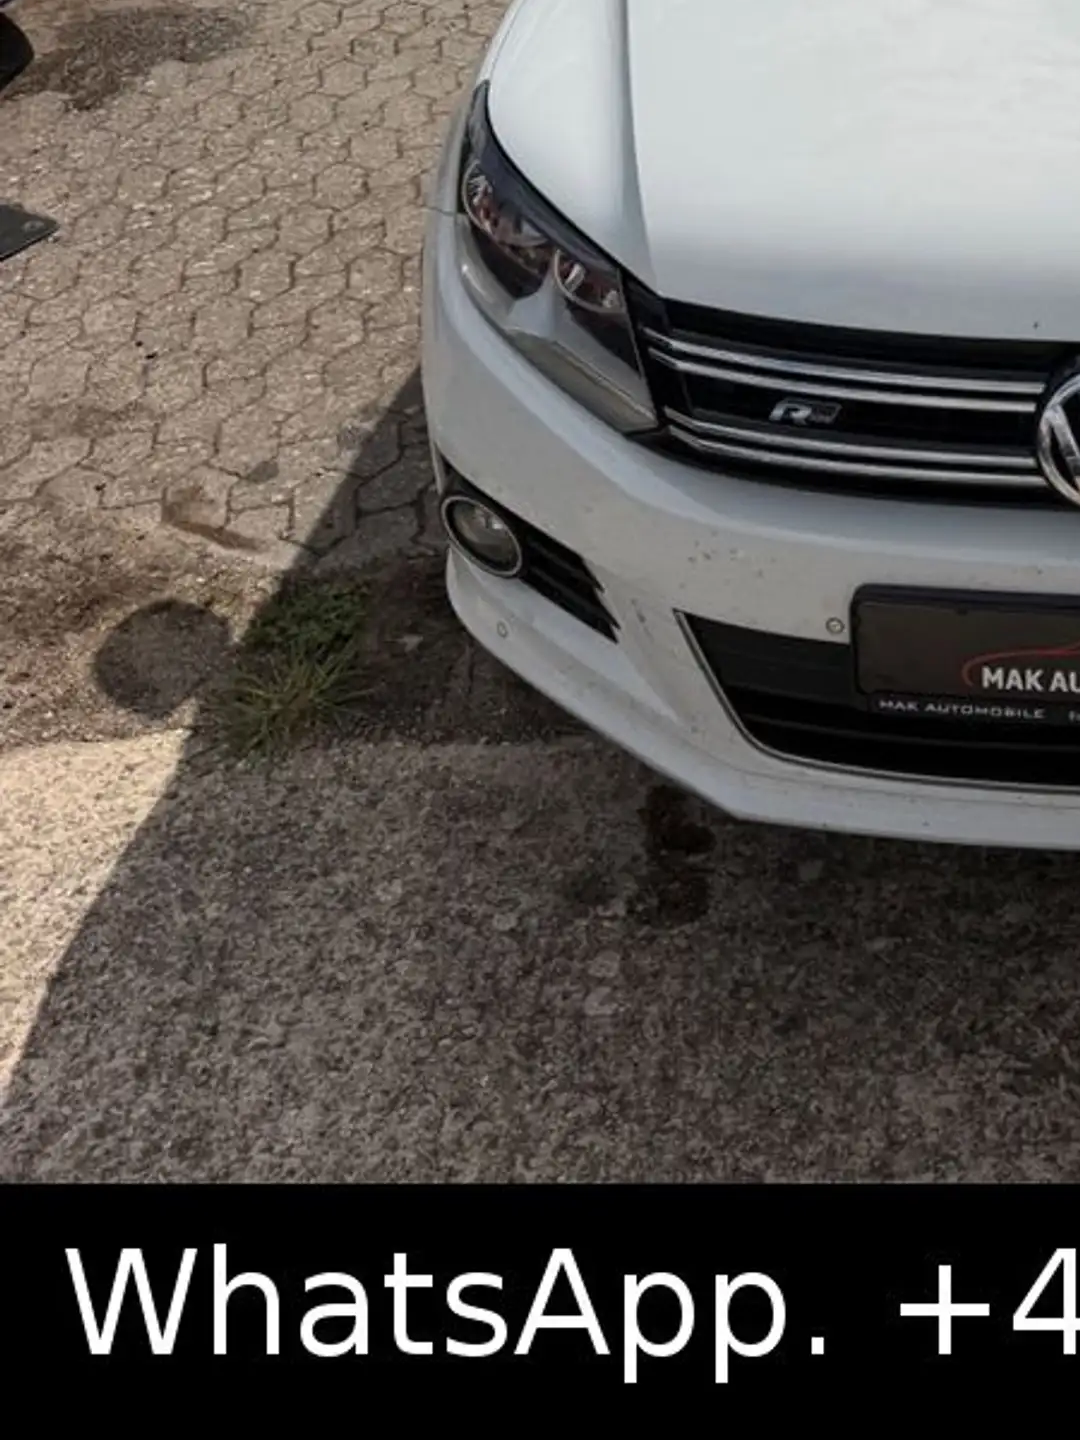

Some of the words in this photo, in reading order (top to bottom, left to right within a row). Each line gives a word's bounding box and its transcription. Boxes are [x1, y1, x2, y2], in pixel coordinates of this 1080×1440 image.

[981, 665, 1044, 692] MAK
[878, 698, 919, 712] MAK
[924, 702, 1046, 719] AUTOMOBILE
